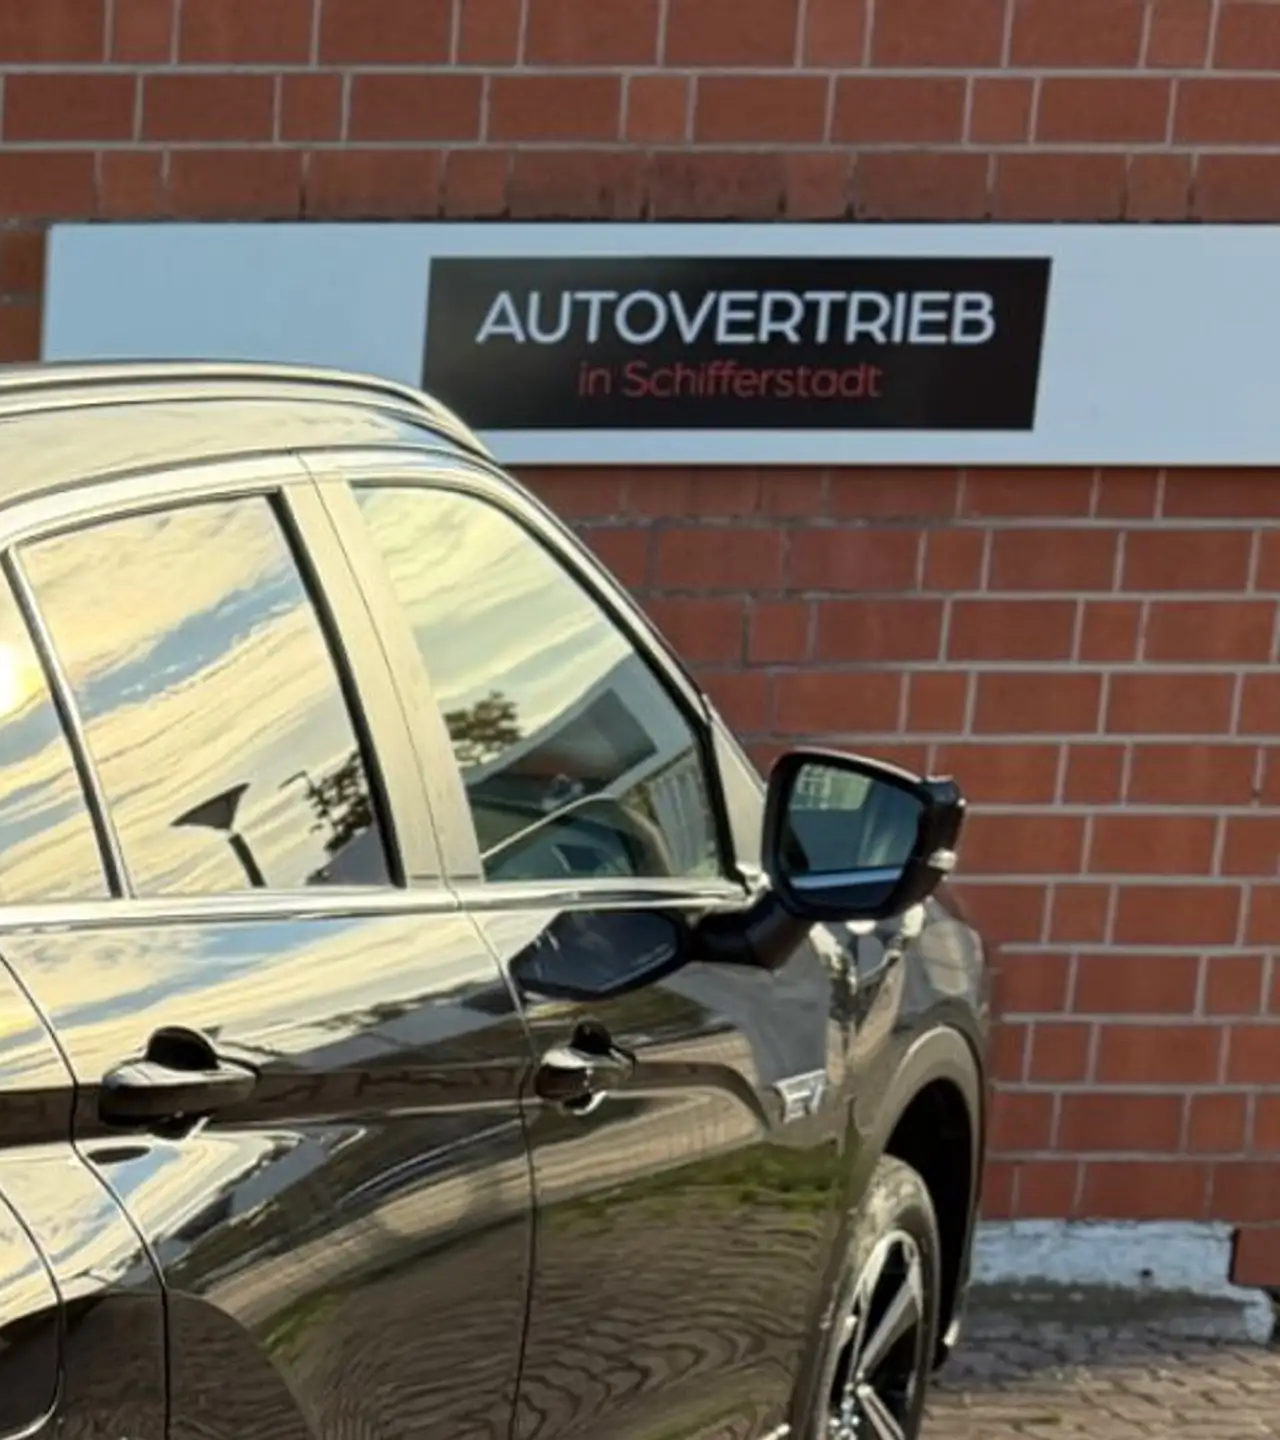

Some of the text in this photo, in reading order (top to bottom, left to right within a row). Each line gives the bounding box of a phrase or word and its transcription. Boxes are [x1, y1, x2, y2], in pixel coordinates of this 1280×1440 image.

[474, 290, 996, 346] AUTOVERTRIEB
[578, 359, 883, 399] in Schifferstadt
